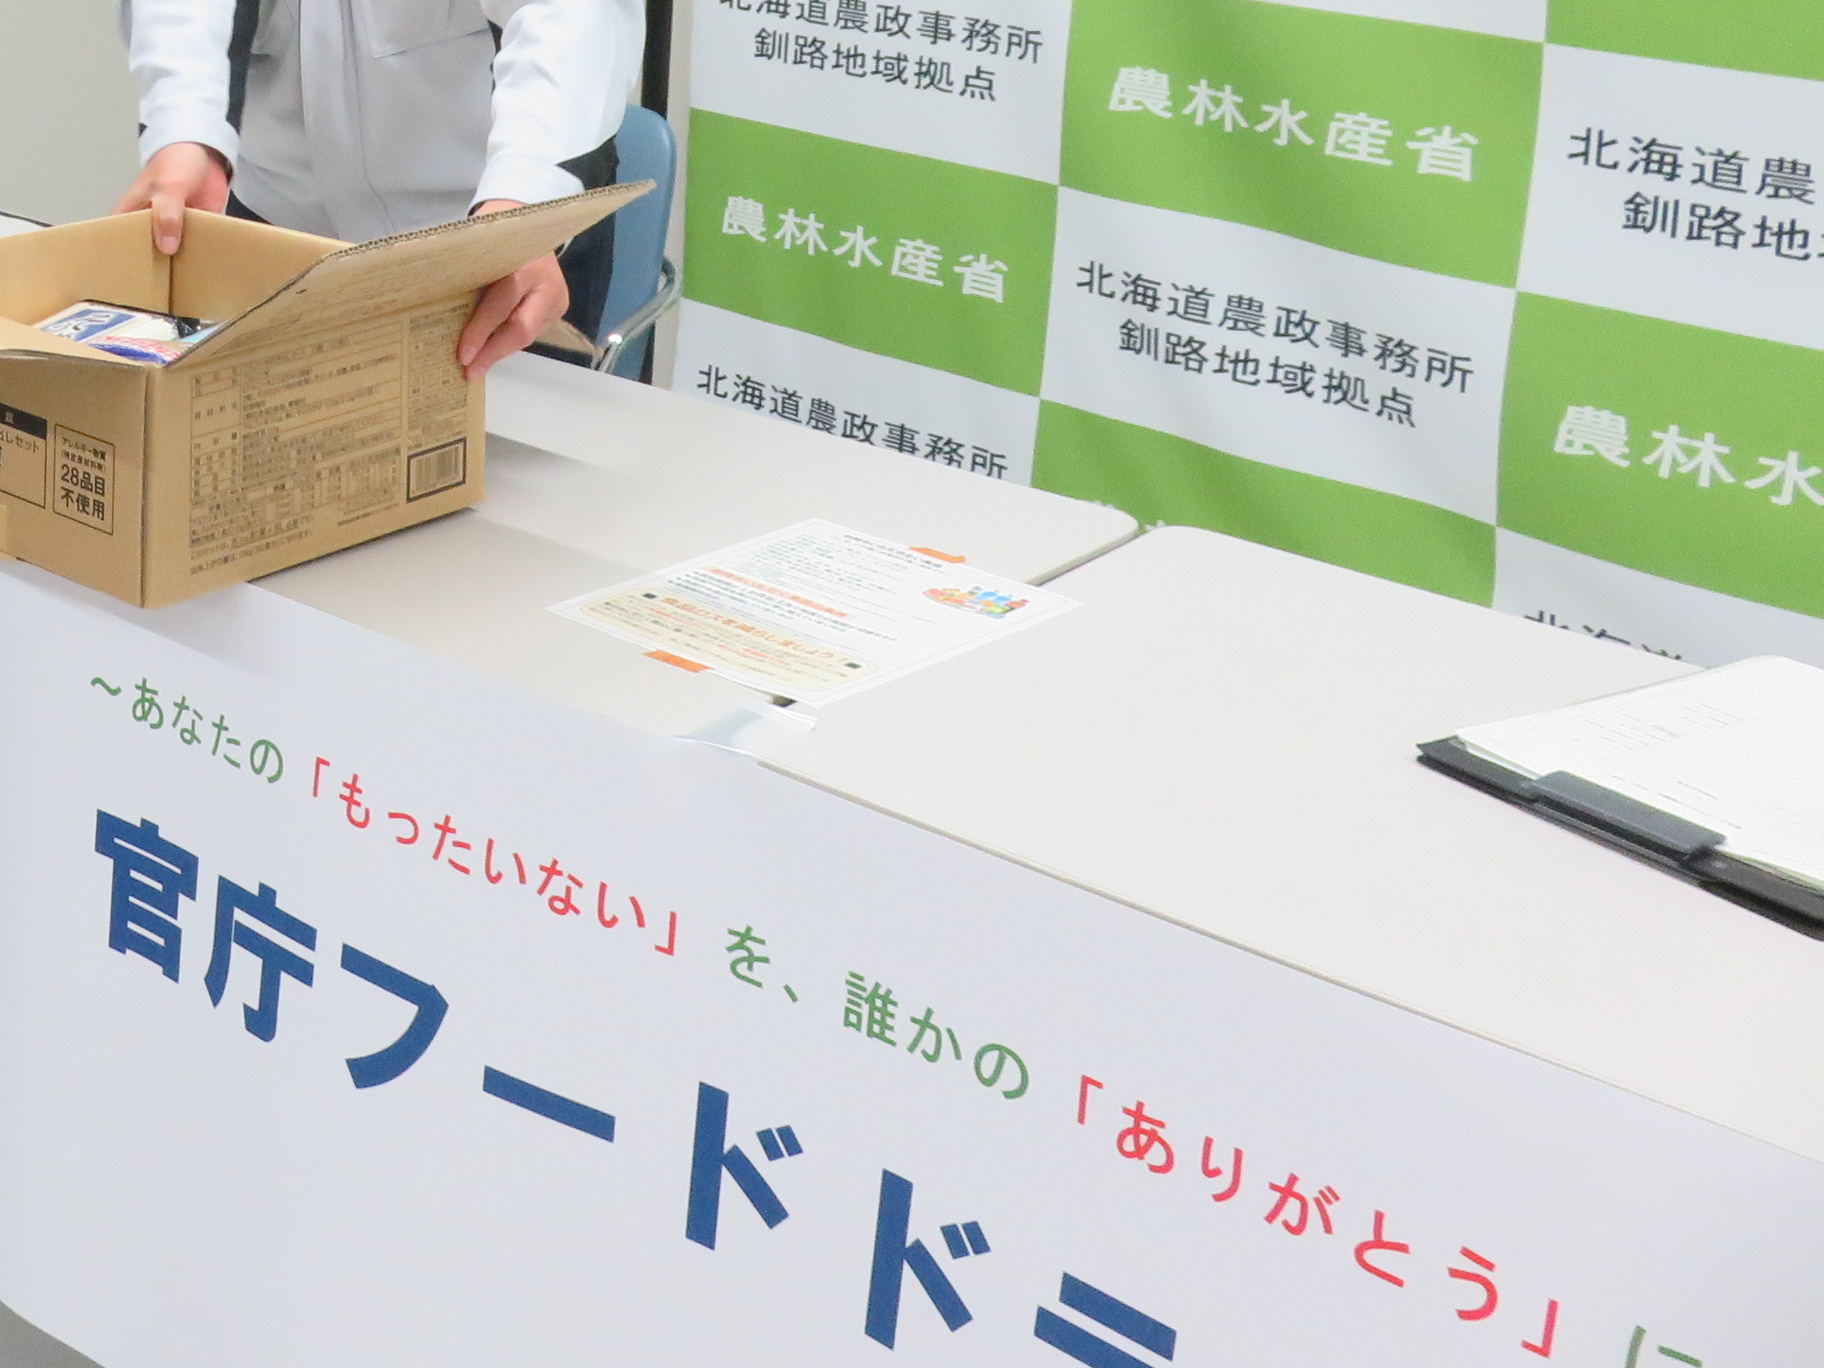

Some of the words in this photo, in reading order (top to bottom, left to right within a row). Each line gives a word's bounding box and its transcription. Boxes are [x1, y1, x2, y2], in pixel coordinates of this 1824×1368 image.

[754, 28, 995, 101] 釧路地域拠点
[1108, 66, 1479, 181] 農林水産省
[1568, 127, 1814, 205] 北海道農
[721, 196, 1009, 303] 農林水産省
[1622, 191, 1824, 261] 釧路地
[1077, 261, 1473, 393] 北海道農政事務所
[1119, 319, 1415, 427] 釧路地域拠点
[697, 365, 1007, 479] 北海道農政事務所
[1552, 405, 1824, 506] 農林水
[60, 485, 106, 522] 不使用
[61, 463, 106, 498] 28品目
